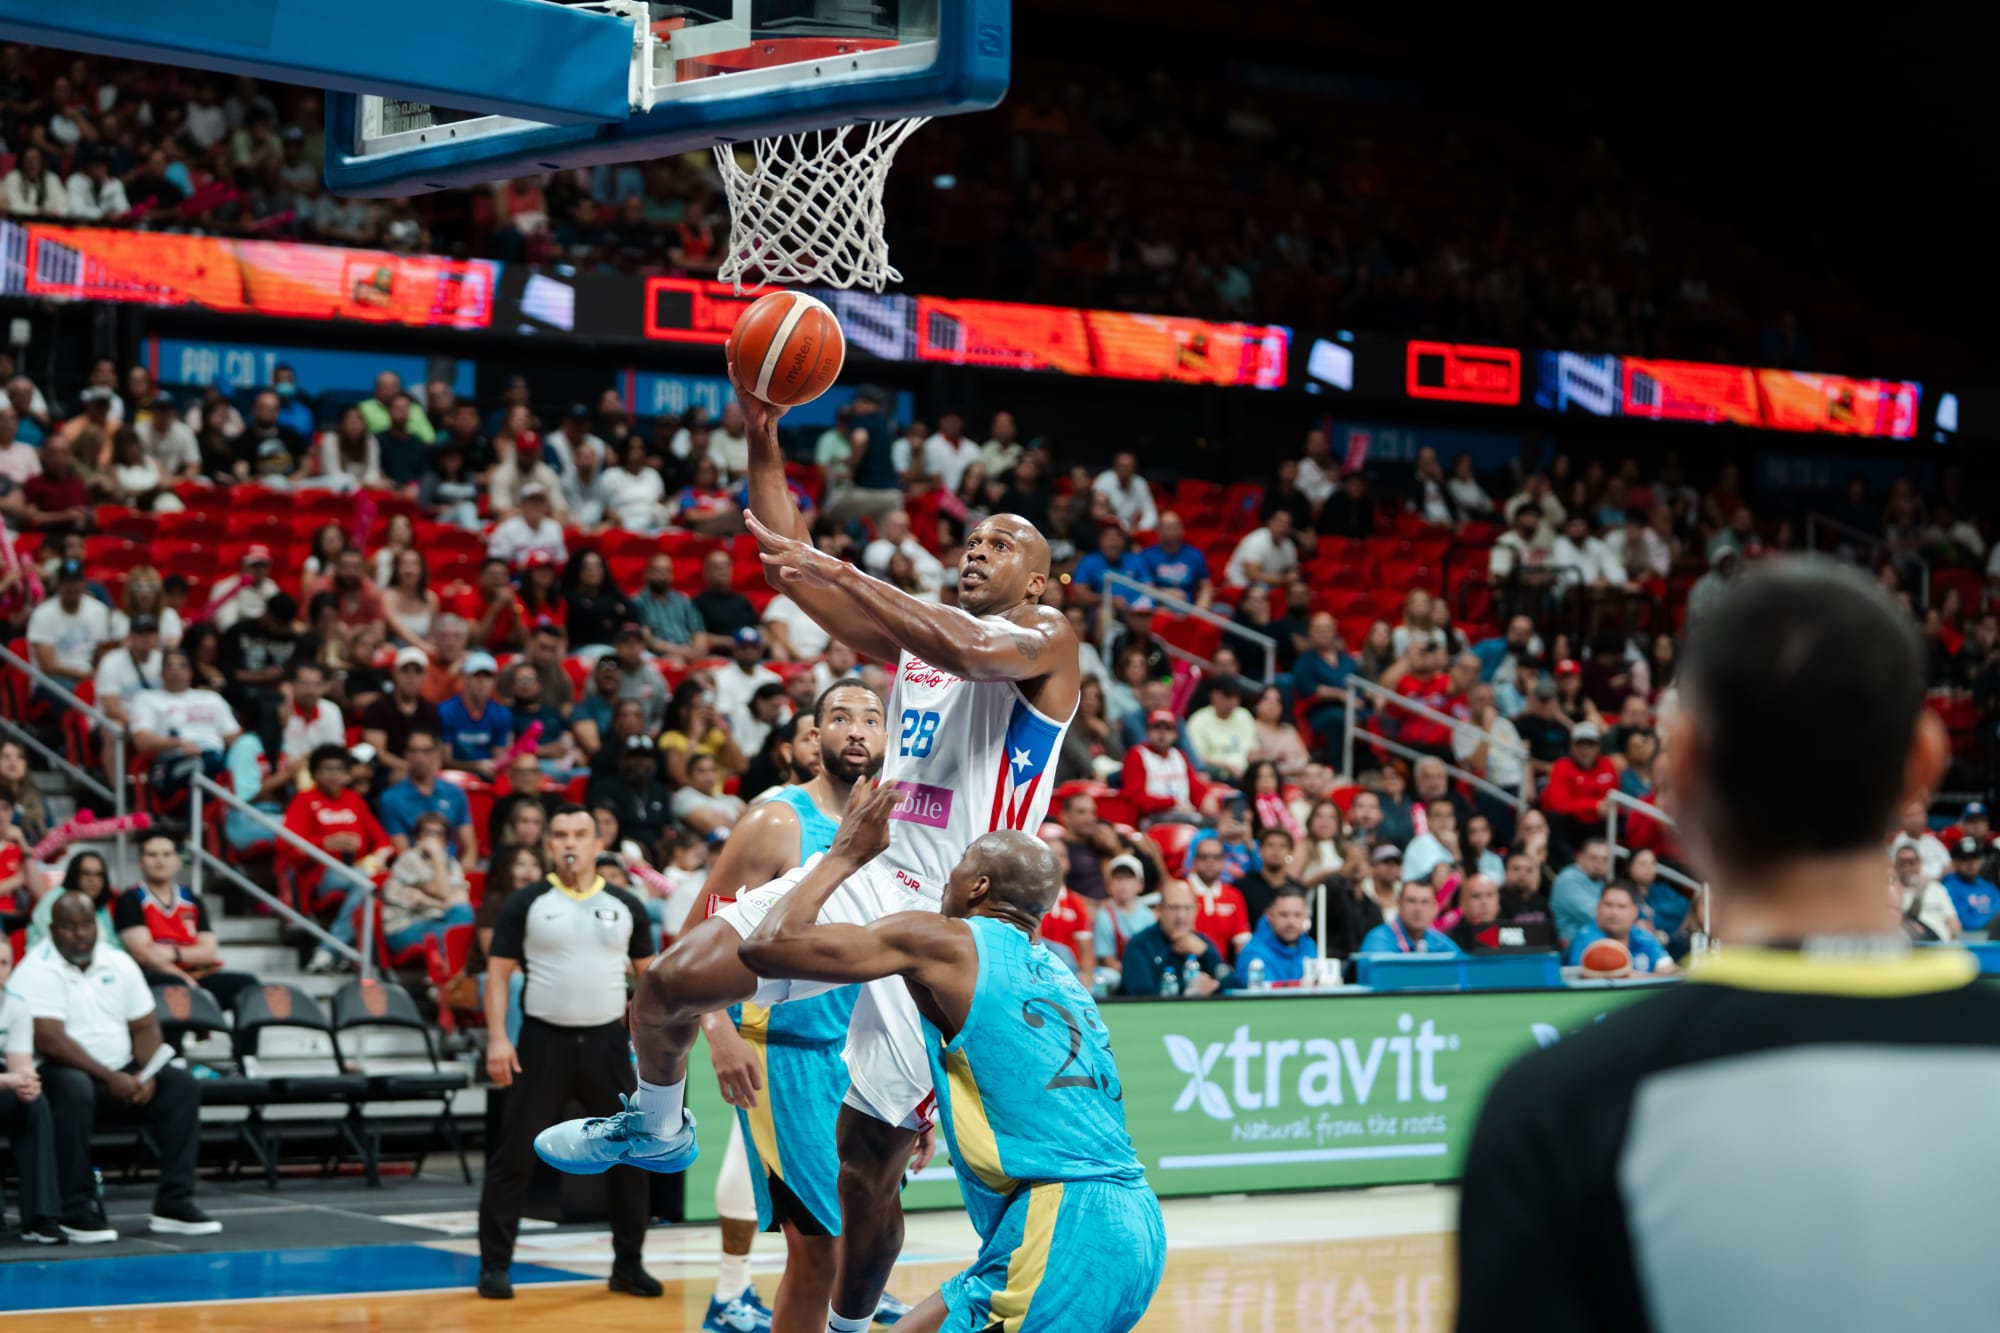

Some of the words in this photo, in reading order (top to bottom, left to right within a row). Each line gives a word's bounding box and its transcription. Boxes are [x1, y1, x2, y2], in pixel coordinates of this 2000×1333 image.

[786, 335, 814, 385] molten
[900, 709, 941, 758] 28
[896, 870, 921, 891] PUR
[1232, 1117, 1310, 1142] Natural
[1316, 1112, 1363, 1145] from
[1368, 1113, 1397, 1136] the
[1401, 1113, 1447, 1134] roots
